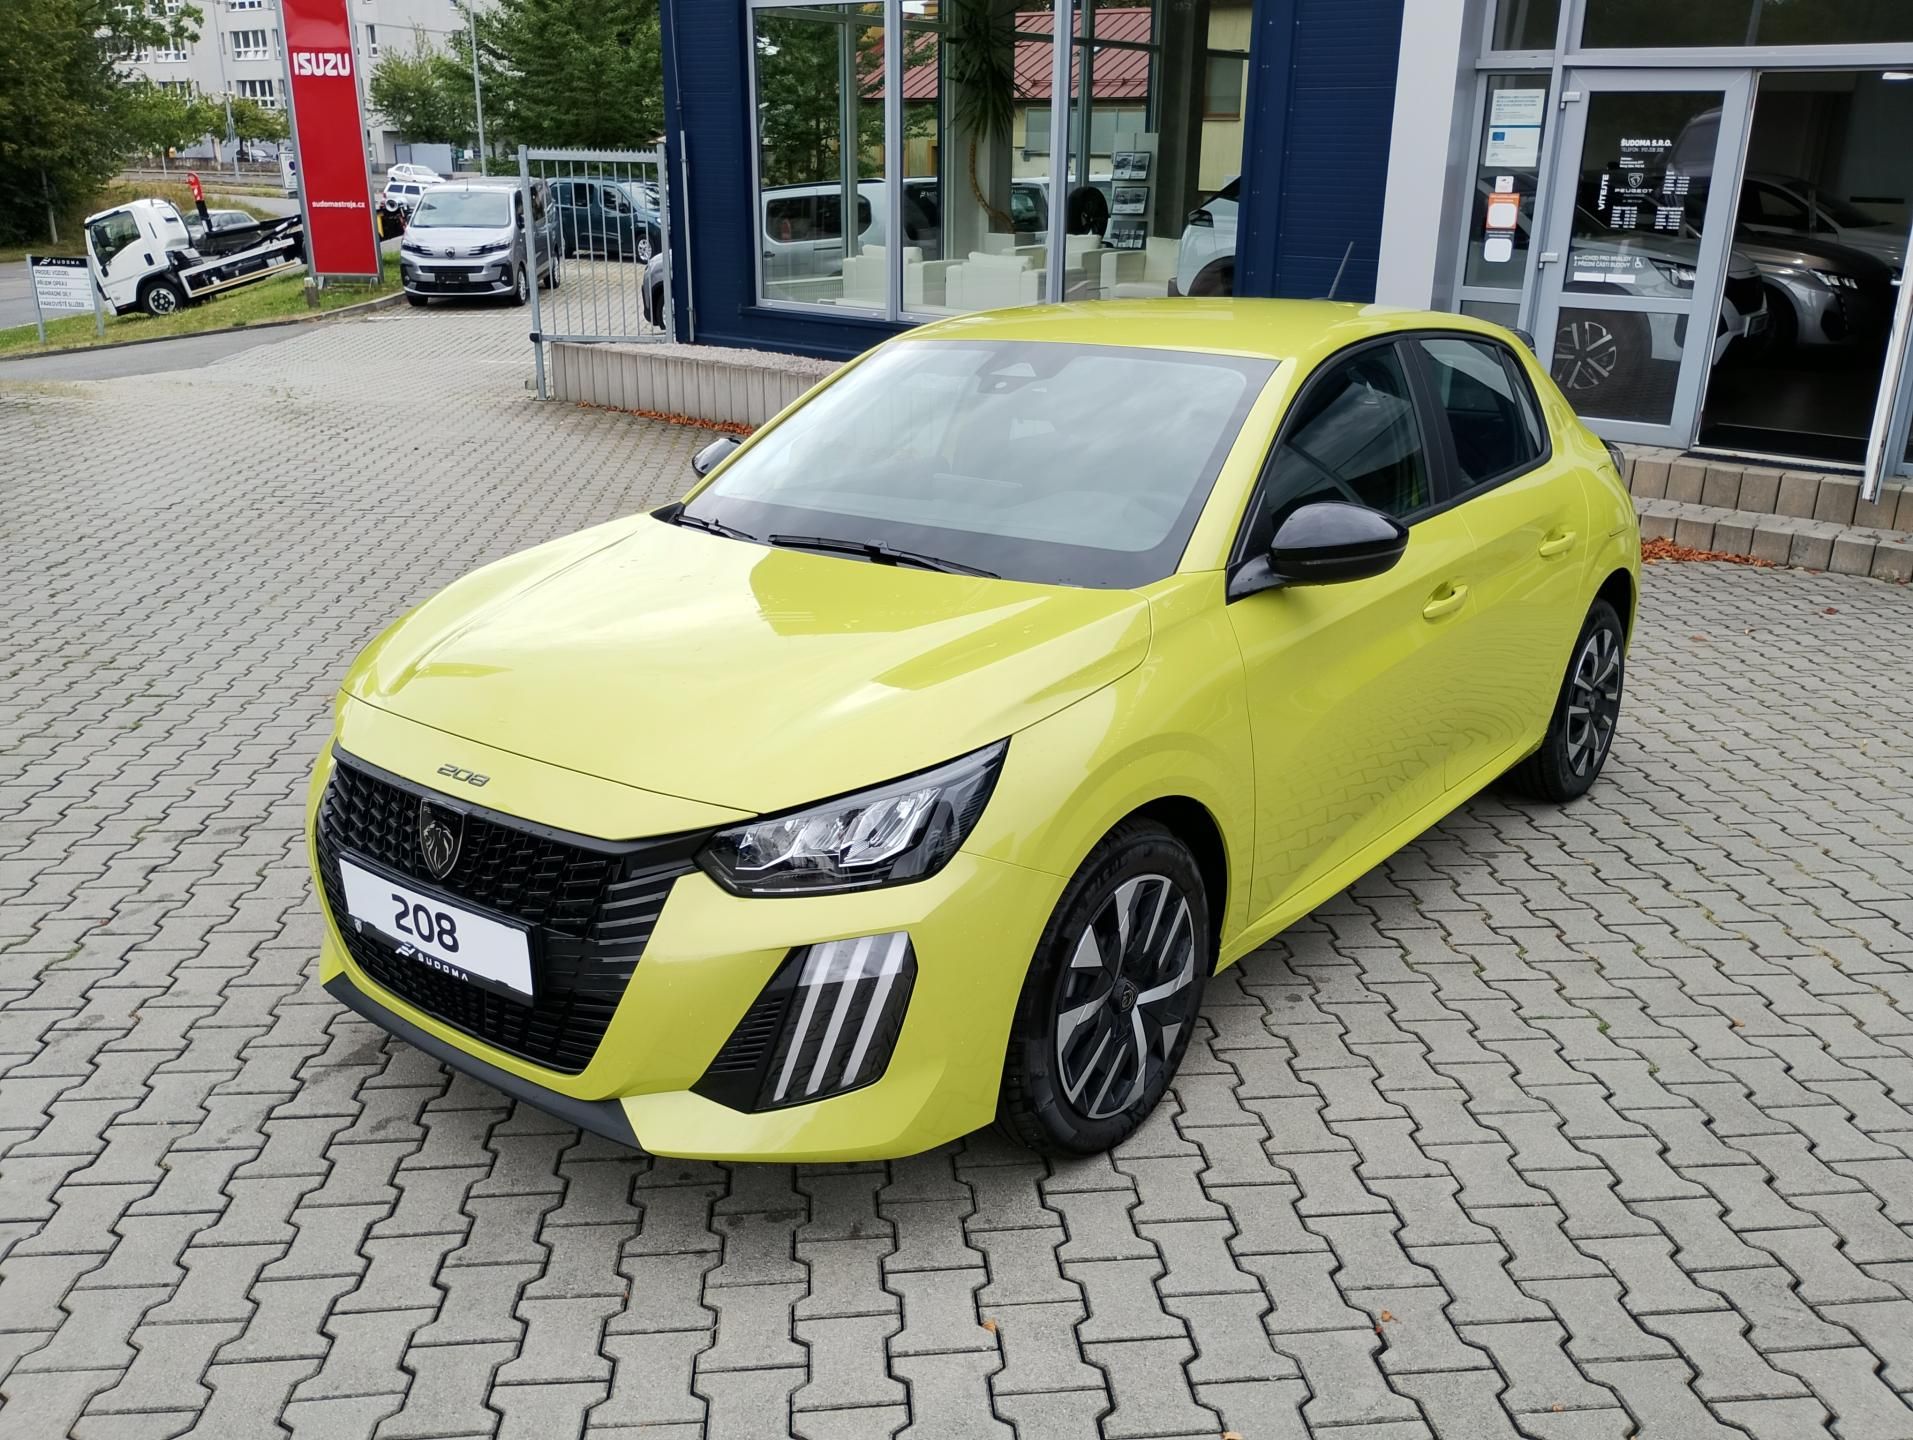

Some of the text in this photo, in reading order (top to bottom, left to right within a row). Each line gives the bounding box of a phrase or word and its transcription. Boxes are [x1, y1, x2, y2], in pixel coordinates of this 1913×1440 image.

[292, 52, 350, 77] ISUZU
[1620, 138, 1672, 147] ŠUDOMA S.R.O.
[1598, 174, 1609, 210] VÍTEJTE
[312, 200, 366, 209] sudomastroje.cz
[437, 763, 490, 787] 208
[391, 893, 460, 953] 208
